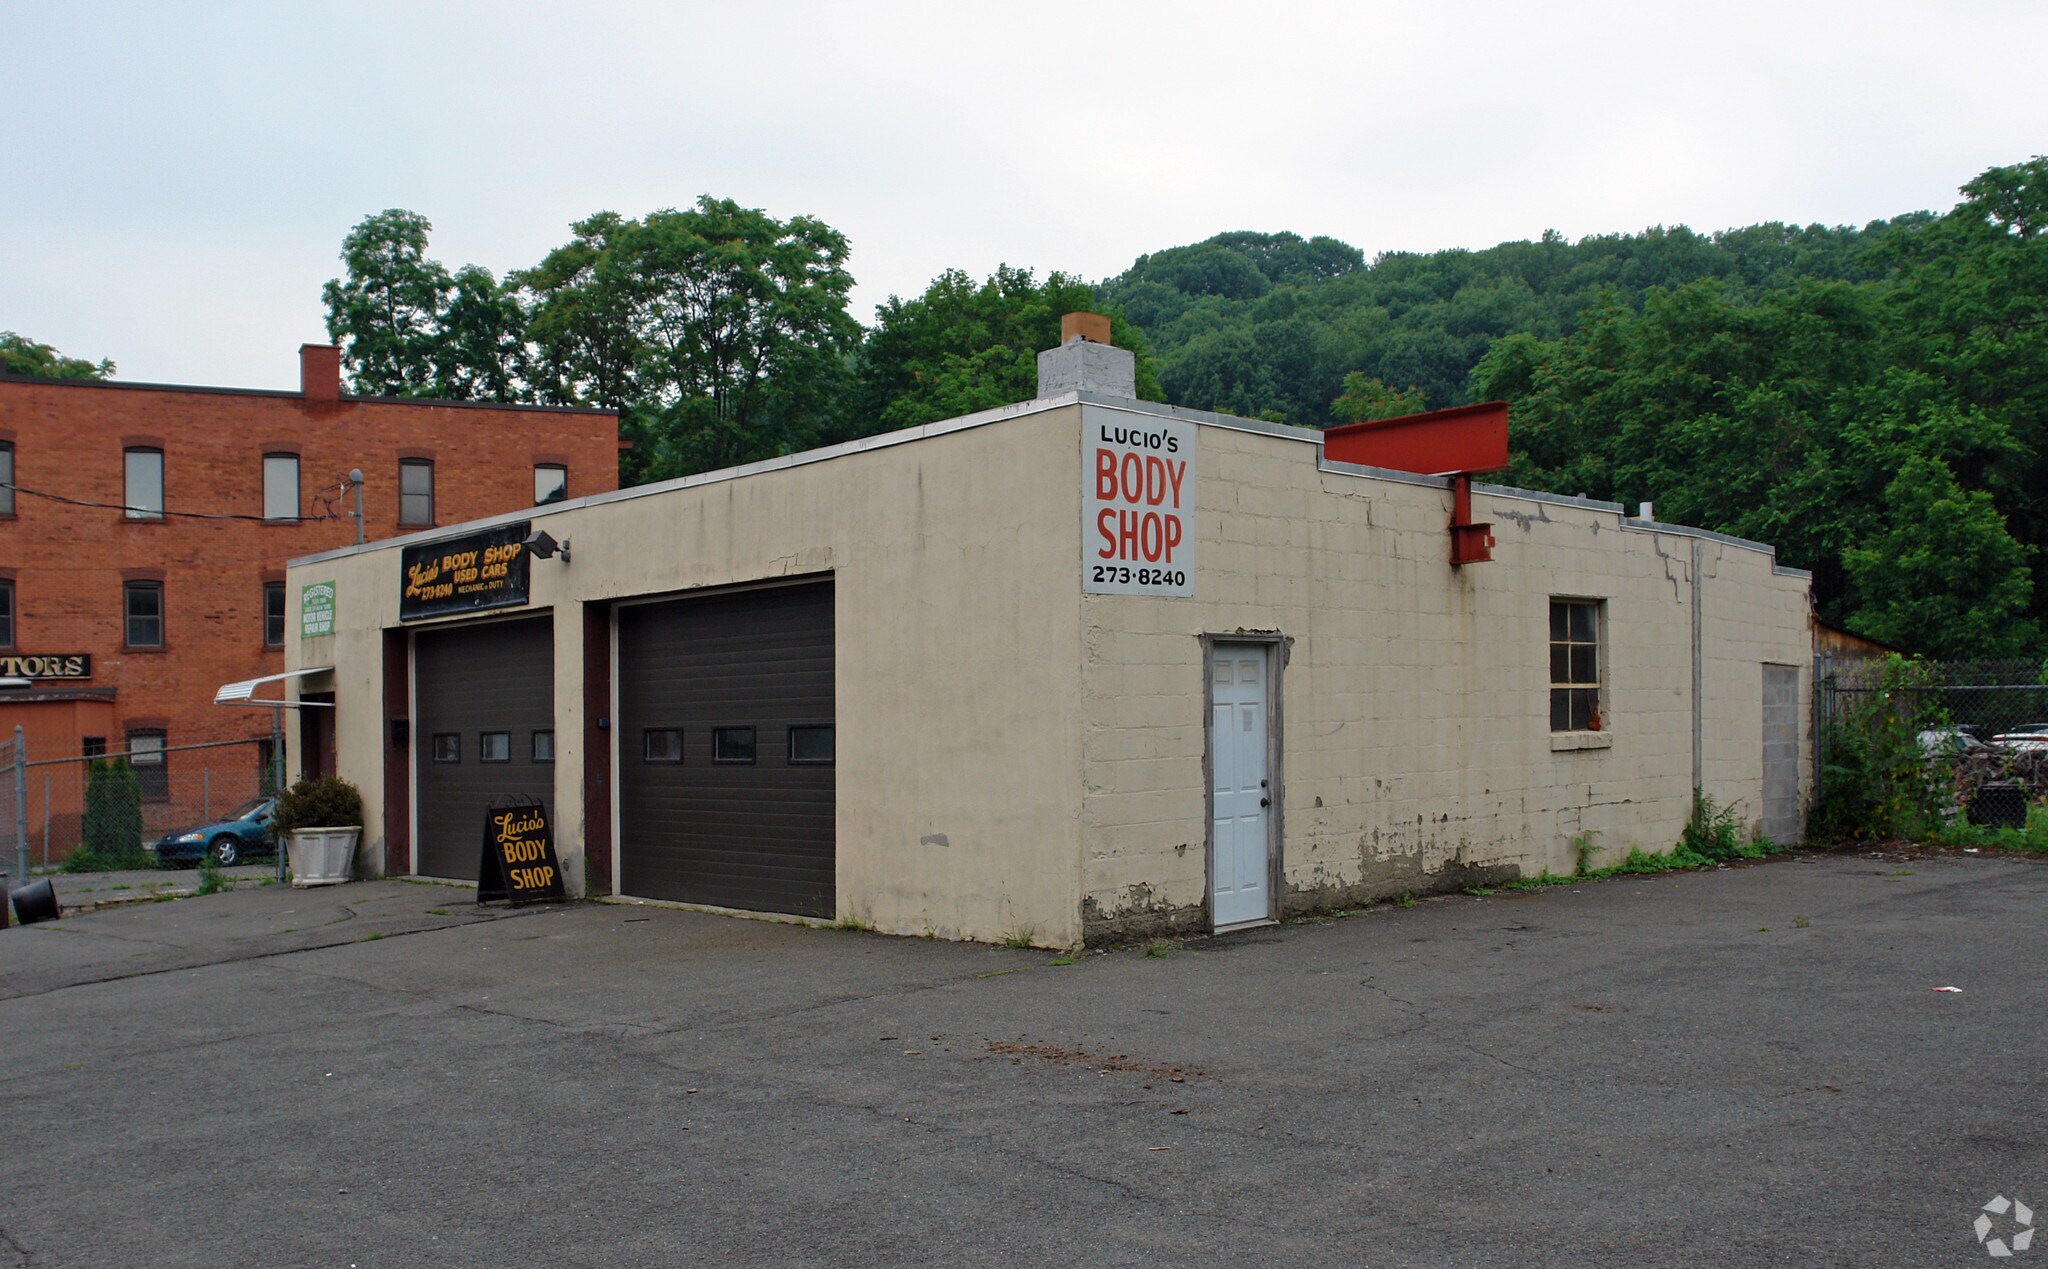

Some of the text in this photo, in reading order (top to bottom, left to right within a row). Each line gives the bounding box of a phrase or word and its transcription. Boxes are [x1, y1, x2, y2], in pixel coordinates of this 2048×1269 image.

[1096, 448, 1186, 509] BODY
[1097, 508, 1181, 563] SHOP
[442, 550, 478, 572] BODY
[483, 543, 521, 564] SHOP
[453, 562, 508, 584] USED CARS
[304, 585, 333, 603] REGISTERED
[458, 583, 484, 594] MECHANIC
[489, 580, 504, 589] DUTY
[317, 610, 332, 621] VEHICLE
[305, 621, 330, 633] REPAIR SHOP
[0, 656, 82, 676] TORS
[494, 810, 544, 842] Lucio's
[503, 839, 546, 863] BODY
[510, 866, 554, 889] SHOP
